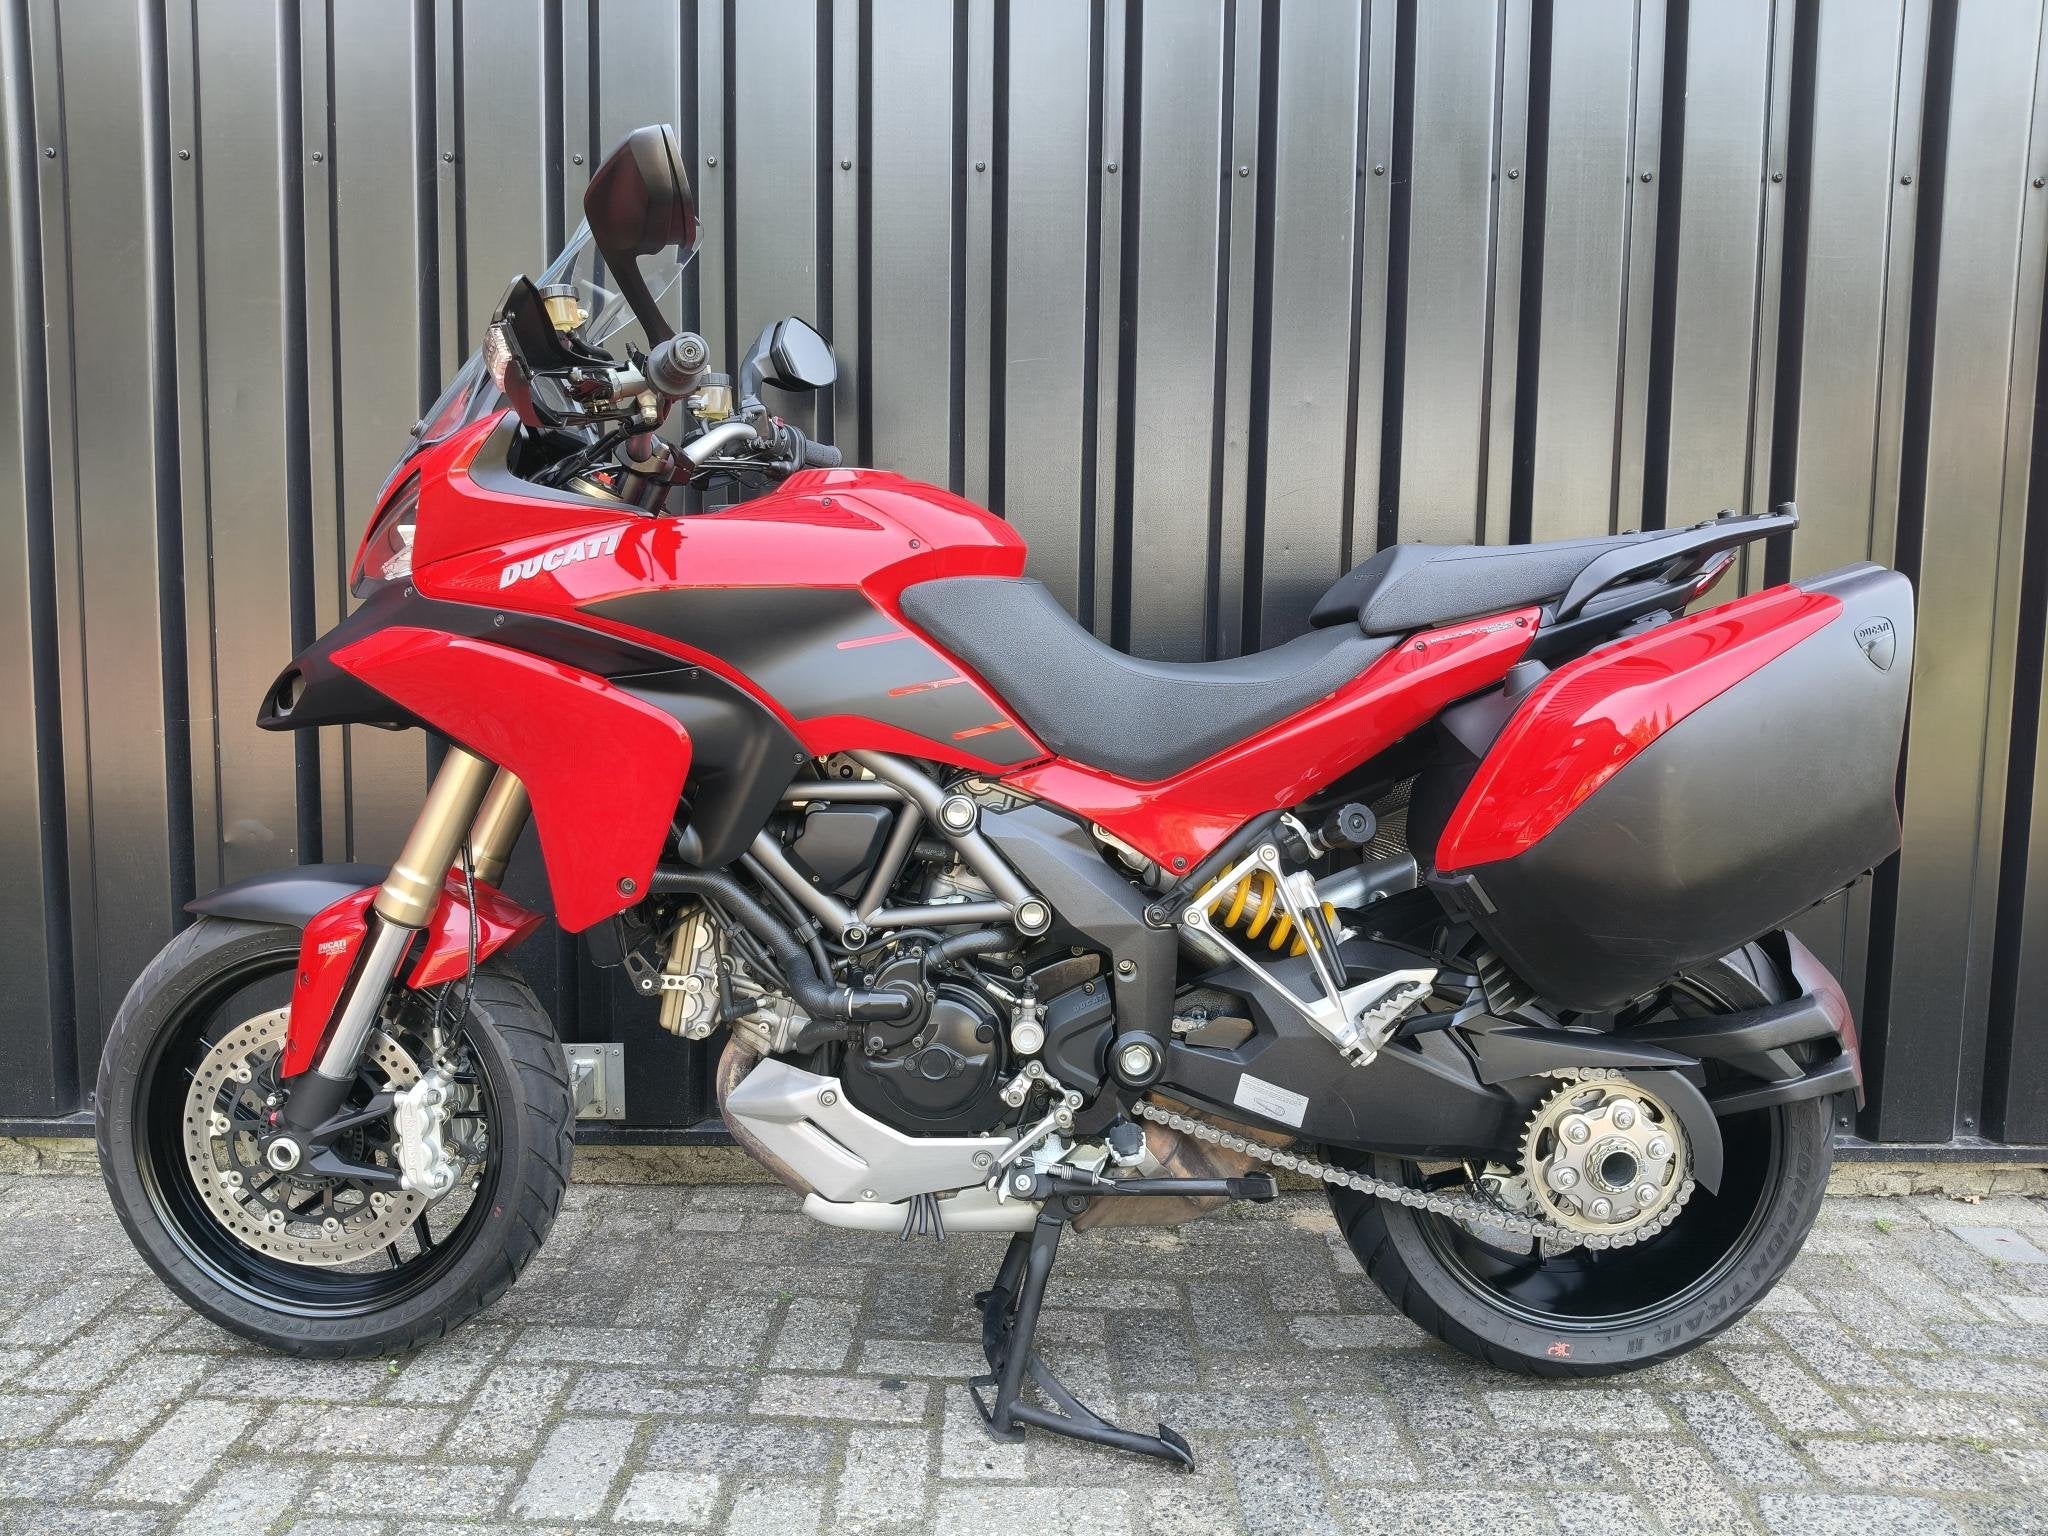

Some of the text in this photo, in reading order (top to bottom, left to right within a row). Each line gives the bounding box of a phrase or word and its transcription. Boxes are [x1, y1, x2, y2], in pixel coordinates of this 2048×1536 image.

[499, 532, 619, 590] DUCATI
[1859, 622, 1889, 639] DUCATI
[318, 939, 347, 954] DUCATI
[1654, 1283, 1746, 1345] TRAIL
